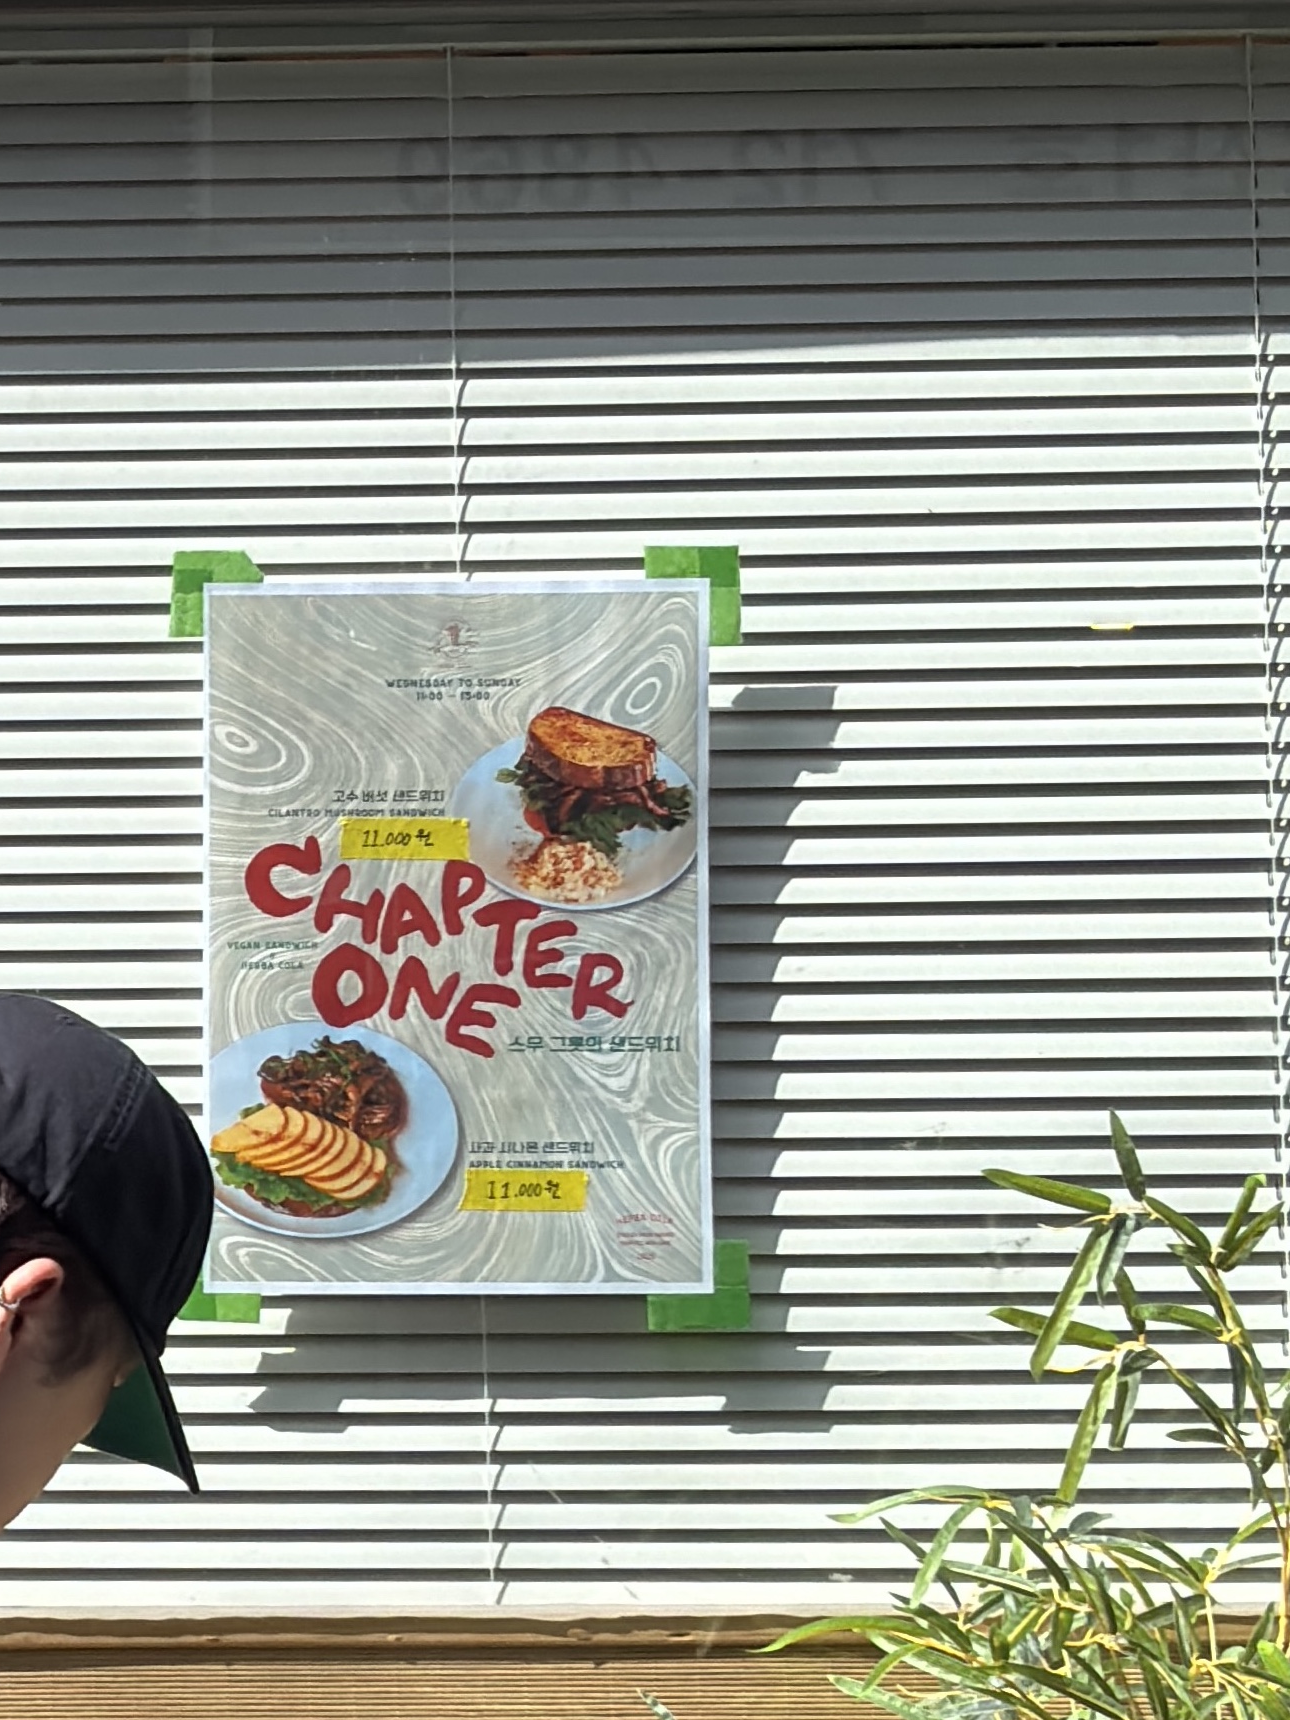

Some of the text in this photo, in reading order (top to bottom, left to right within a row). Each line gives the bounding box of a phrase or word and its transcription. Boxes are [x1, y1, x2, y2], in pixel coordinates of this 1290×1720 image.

[385, 679, 521, 689] WEDNESDAY TO SUNDAY
[332, 790, 359, 803] 고수
[268, 808, 445, 818] CILANTRO MUSHROOM SANDWICH
[245, 836, 634, 1020] CHAPTER
[312, 944, 521, 1058] ONE
[508, 1036, 544, 1052] 스무
[609, 1036, 680, 1052] 샌드위치
[469, 1160, 624, 1169] APPLE CINNAMON SANDWICH
